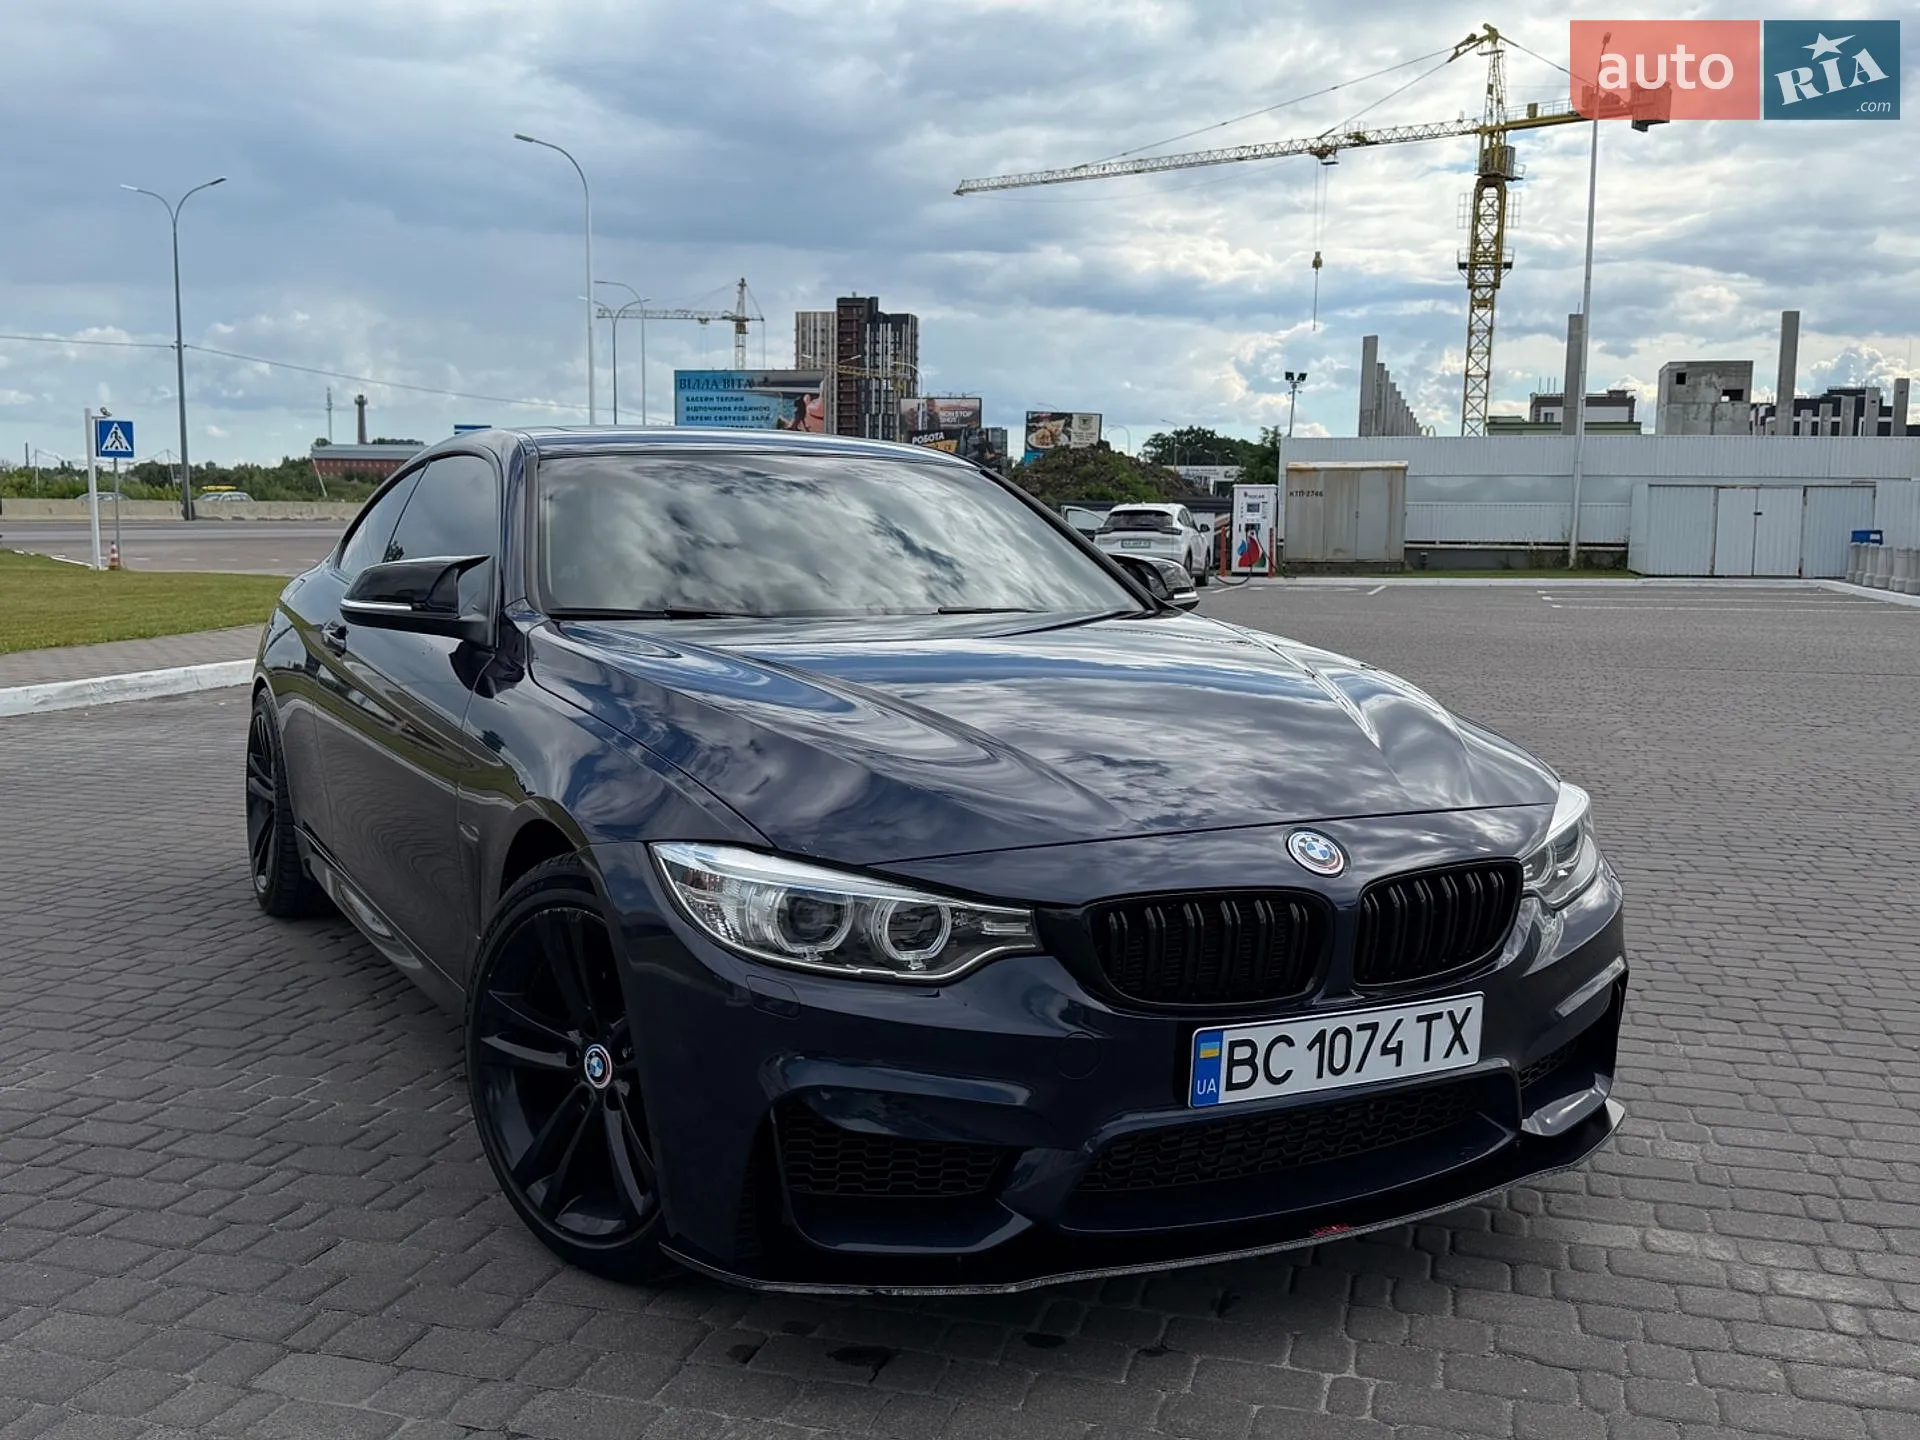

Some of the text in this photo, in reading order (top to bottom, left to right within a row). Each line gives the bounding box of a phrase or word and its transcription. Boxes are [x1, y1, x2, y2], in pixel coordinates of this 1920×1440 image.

[679, 378, 754, 390] ВІЛЛА ВІТА
[912, 431, 945, 445] РОБОТА
[1225, 1006, 1473, 1092] BC 1074 TX
[1197, 1080, 1217, 1095] UA
